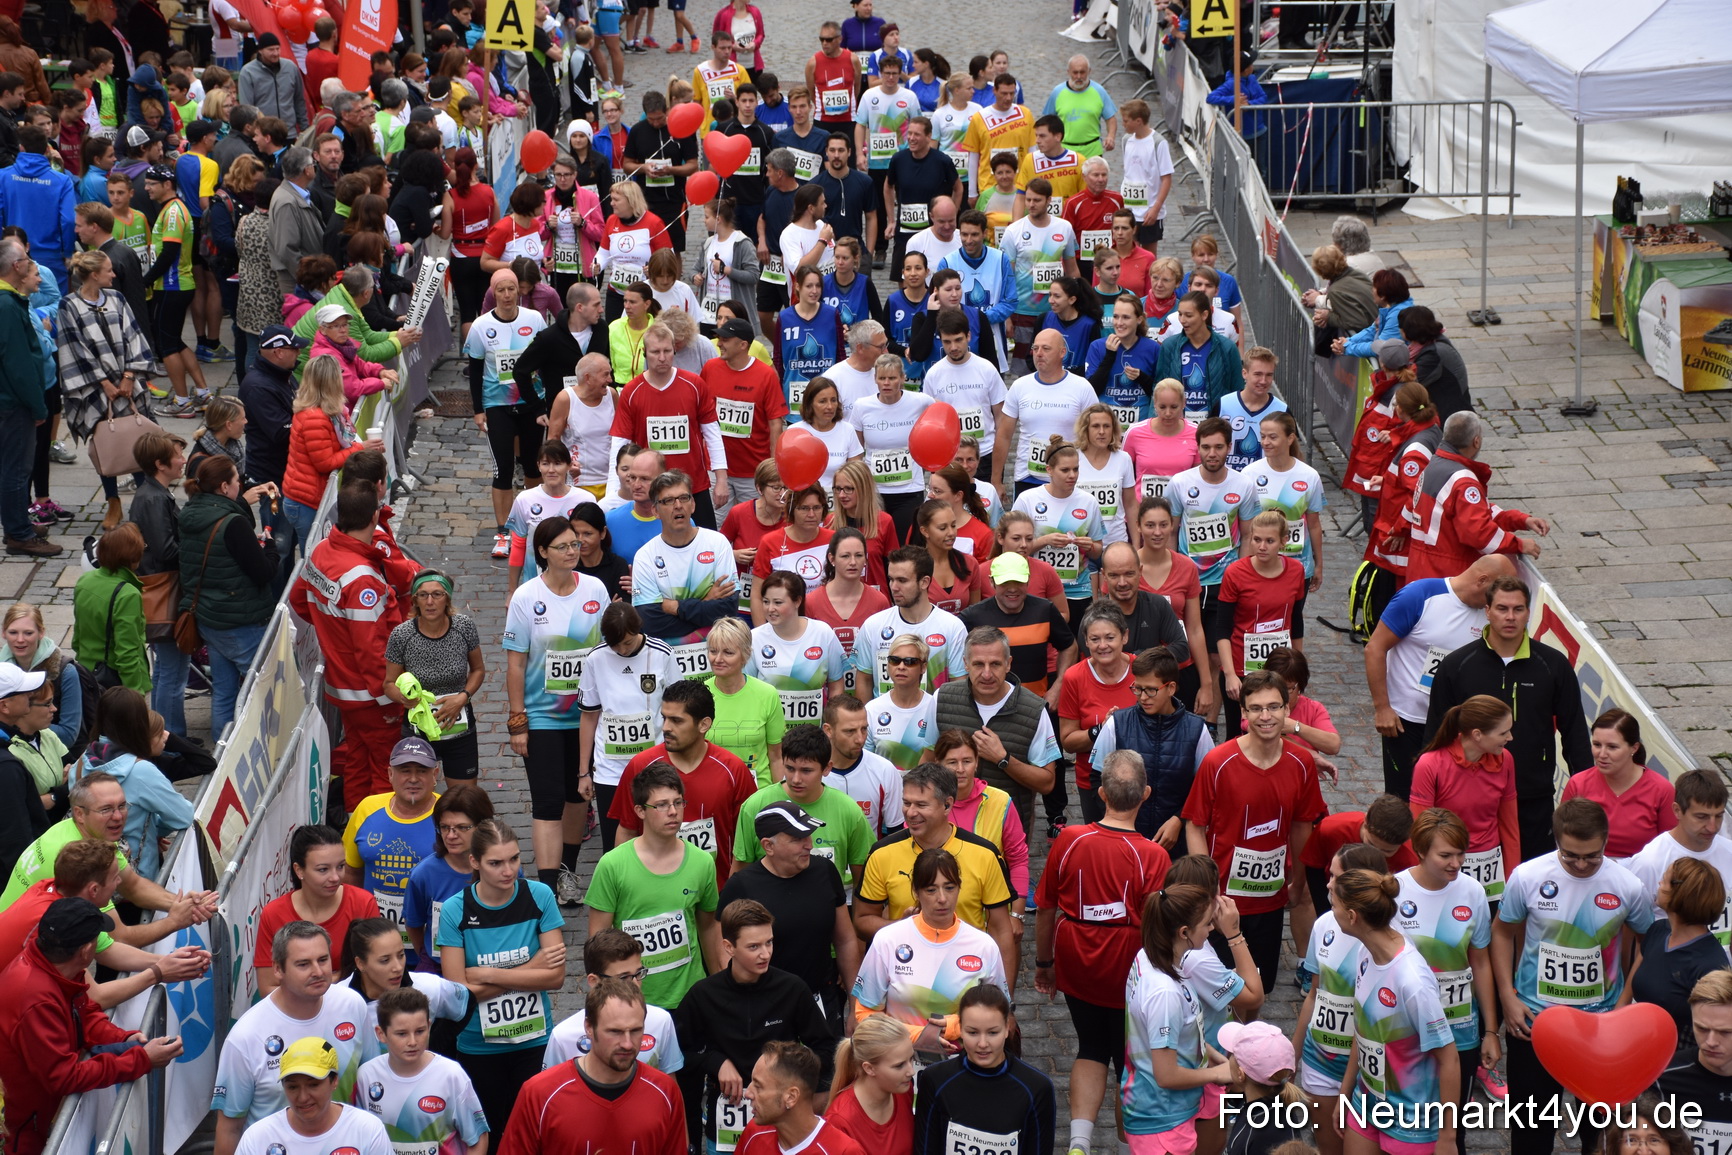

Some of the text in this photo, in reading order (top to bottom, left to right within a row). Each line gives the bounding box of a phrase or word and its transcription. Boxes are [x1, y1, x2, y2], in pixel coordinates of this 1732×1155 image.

[1202, 0, 1229, 21] A
[497, 0, 523, 35] A
[825, 95, 848, 107] 2199
[990, 120, 1028, 139] MAX BÖGL
[872, 138, 895, 150] 5049
[12, 174, 31, 183] Team
[1057, 168, 1078, 178] BÖGL
[1122, 188, 1145, 200] 5131
[901, 210, 925, 223] 5304
[1036, 269, 1062, 282] 5058
[894, 309, 906, 322] 9
[784, 326, 800, 341] 11
[718, 407, 750, 425] 5170
[651, 425, 686, 441] 5110
[659, 442, 679, 450] Jürgen
[875, 456, 909, 474] 5014
[884, 474, 902, 482] Esther
[1199, 518, 1221, 526] Neumarkt
[1189, 523, 1227, 542] 5319
[551, 660, 582, 678] 504
[676, 654, 708, 674] 519
[566, 681, 577, 690] Ina
[608, 723, 651, 742] 5194
[615, 745, 644, 754] Melanie
[1255, 825, 1270, 834] DEHN
[1235, 851, 1280, 862] PARTL Neumarkt
[1476, 854, 1496, 863] Neumarkt
[1237, 859, 1281, 881] 5033
[1241, 882, 1273, 892] Andreas
[1597, 896, 1619, 906] Hervis
[1093, 907, 1115, 917] DEHN
[1454, 908, 1470, 918] Hervis
[624, 917, 674, 933] PARTL Neumarkt
[477, 945, 530, 966] HUBER
[1540, 948, 1594, 960] PARTL Neumarkt
[895, 964, 914, 973] PARTL
[960, 959, 981, 969] Hervis
[1544, 958, 1599, 984] 5156
[1212, 977, 1236, 999] BOCK
[1546, 985, 1595, 997] Maximilian
[487, 992, 539, 1025] 5022
[1328, 999, 1354, 1010] Neumark
[336, 1026, 354, 1037] Hervis
[498, 1022, 534, 1038] Christine
[1322, 1034, 1353, 1047] Barbara
[421, 1099, 443, 1110] Hervis
[949, 1128, 972, 1143] PARTL
[973, 1136, 1008, 1148] Neumarkt
